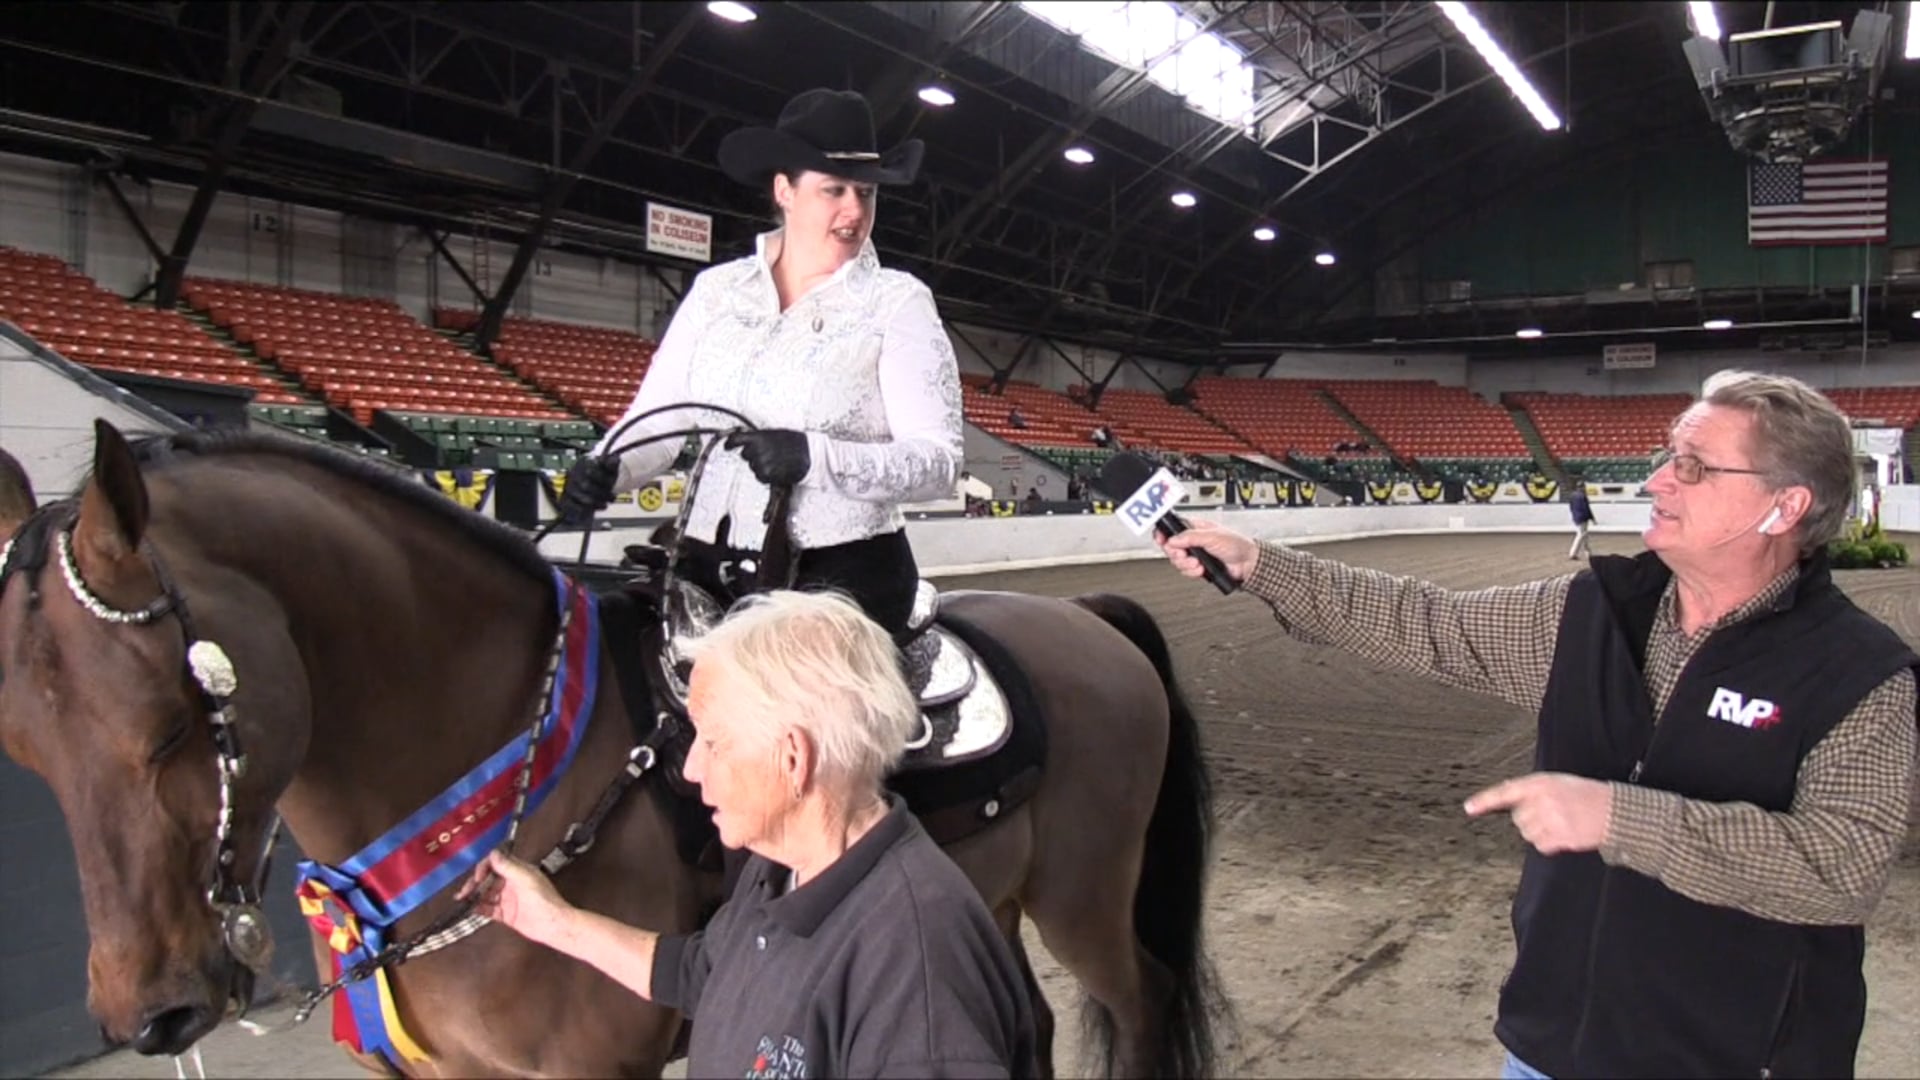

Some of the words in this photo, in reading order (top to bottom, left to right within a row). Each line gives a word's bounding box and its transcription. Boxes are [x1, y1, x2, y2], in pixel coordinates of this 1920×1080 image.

[252, 213, 278, 232] 12
[651, 210, 665, 222] NO
[669, 213, 708, 231] SMOKING
[651, 223, 660, 234] IN
[664, 225, 708, 244] COLISEUM
[1125, 480, 1167, 526] RVP
[1707, 686, 1775, 728] RVP
